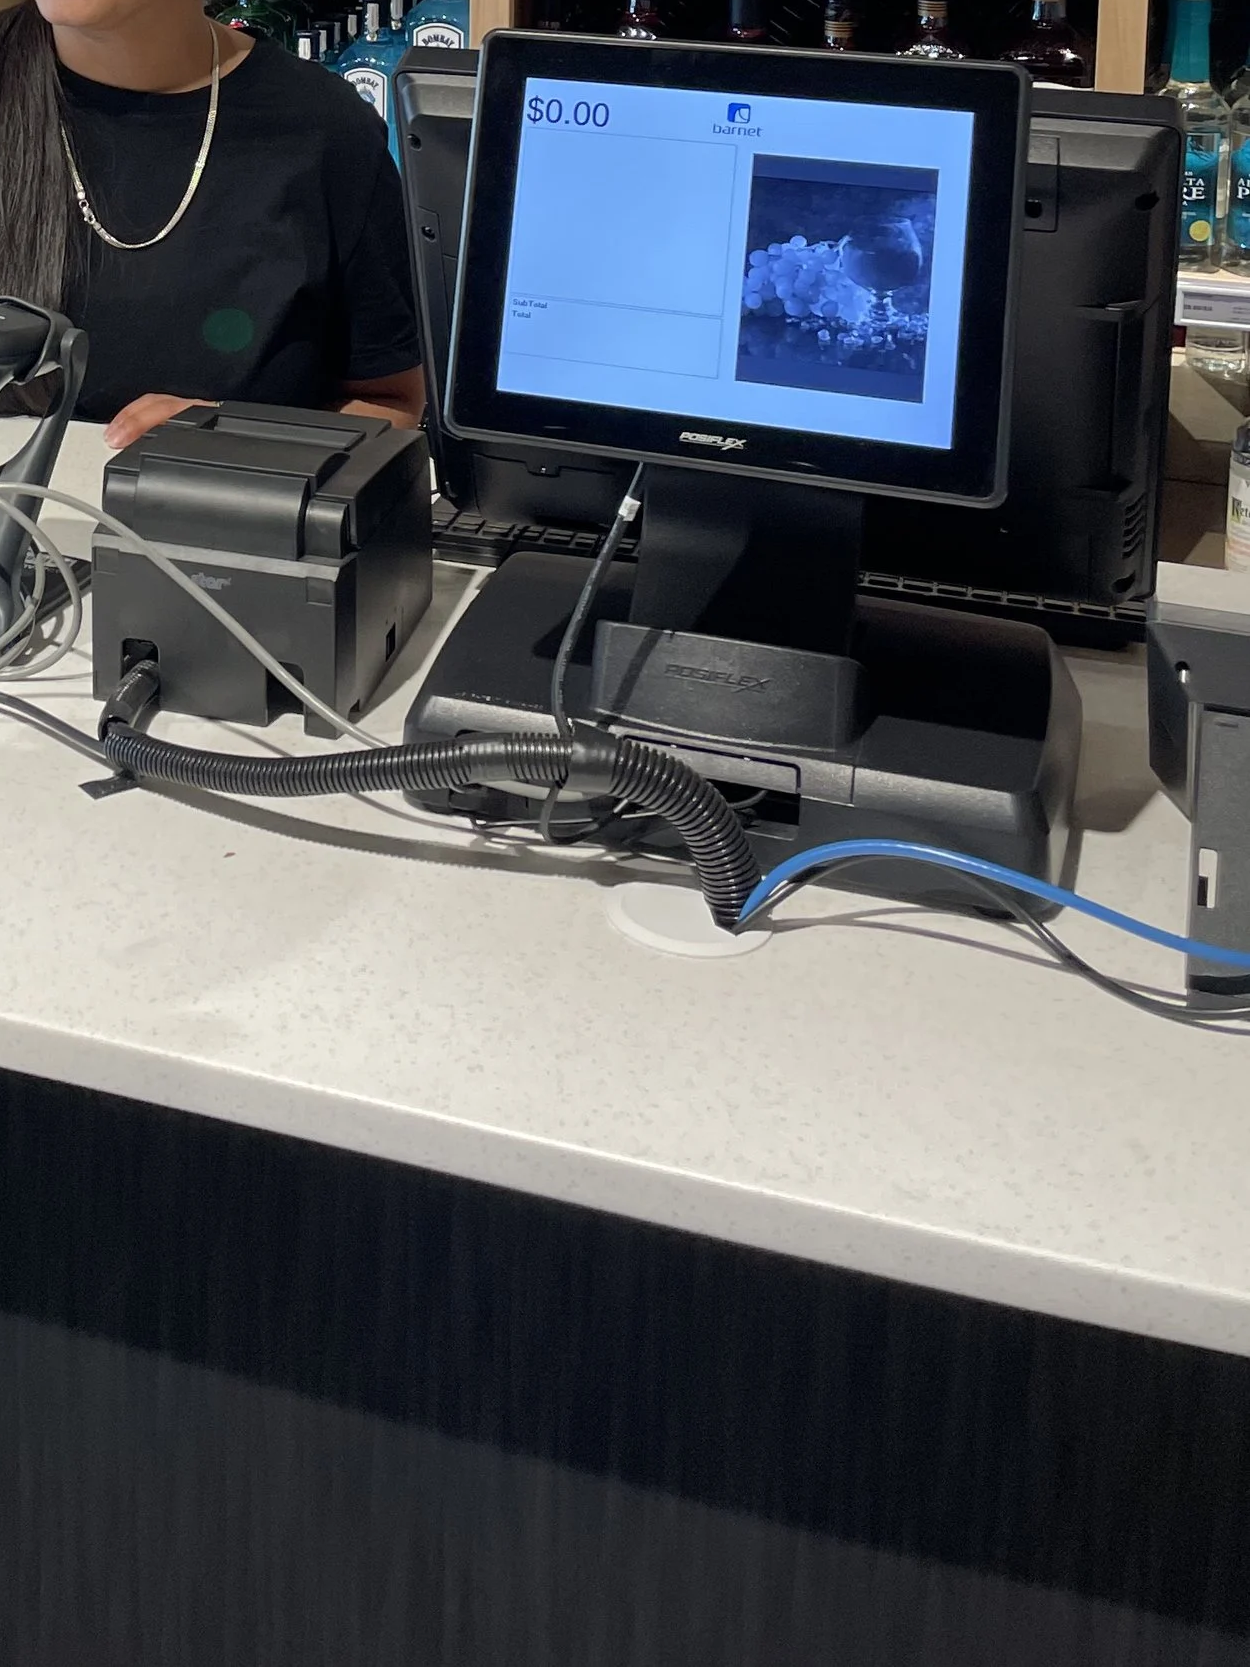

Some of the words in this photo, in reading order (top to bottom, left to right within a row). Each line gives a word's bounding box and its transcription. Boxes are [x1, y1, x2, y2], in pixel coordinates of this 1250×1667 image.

[421, 33, 454, 46] BOMBAY
[526, 95, 610, 128] $0.00
[712, 121, 763, 138] barnet
[512, 310, 531, 319] Total
[679, 431, 748, 451] POSIFLEX
[664, 662, 772, 694] POSIFLEX
